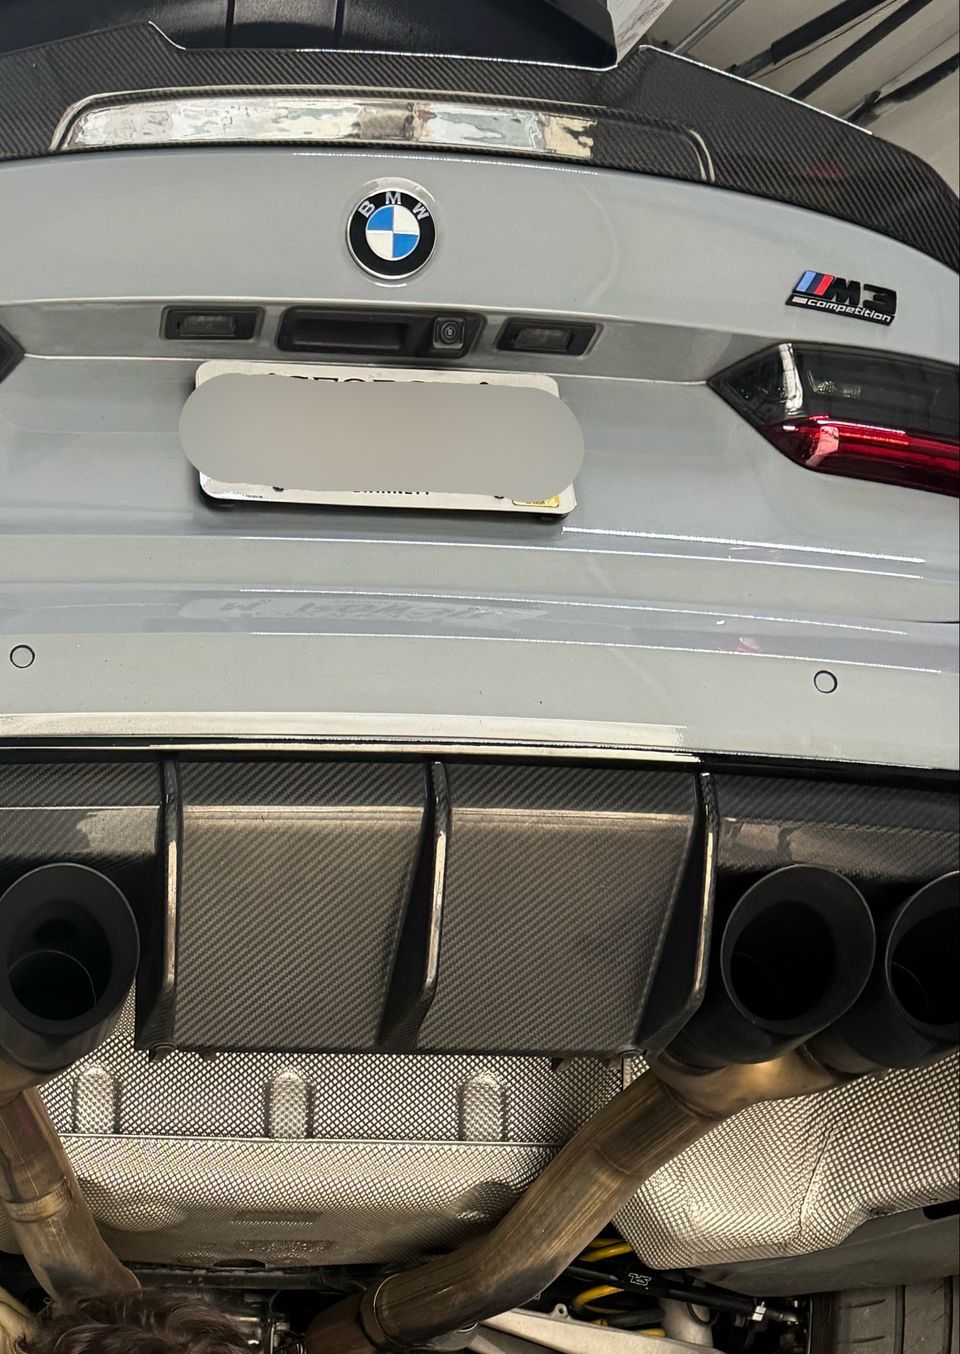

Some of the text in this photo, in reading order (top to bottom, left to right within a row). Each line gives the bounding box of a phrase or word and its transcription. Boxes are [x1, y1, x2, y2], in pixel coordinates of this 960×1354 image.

[358, 191, 429, 220] BMW
[807, 299, 891, 322] competition
[824, 277, 897, 315] M3
